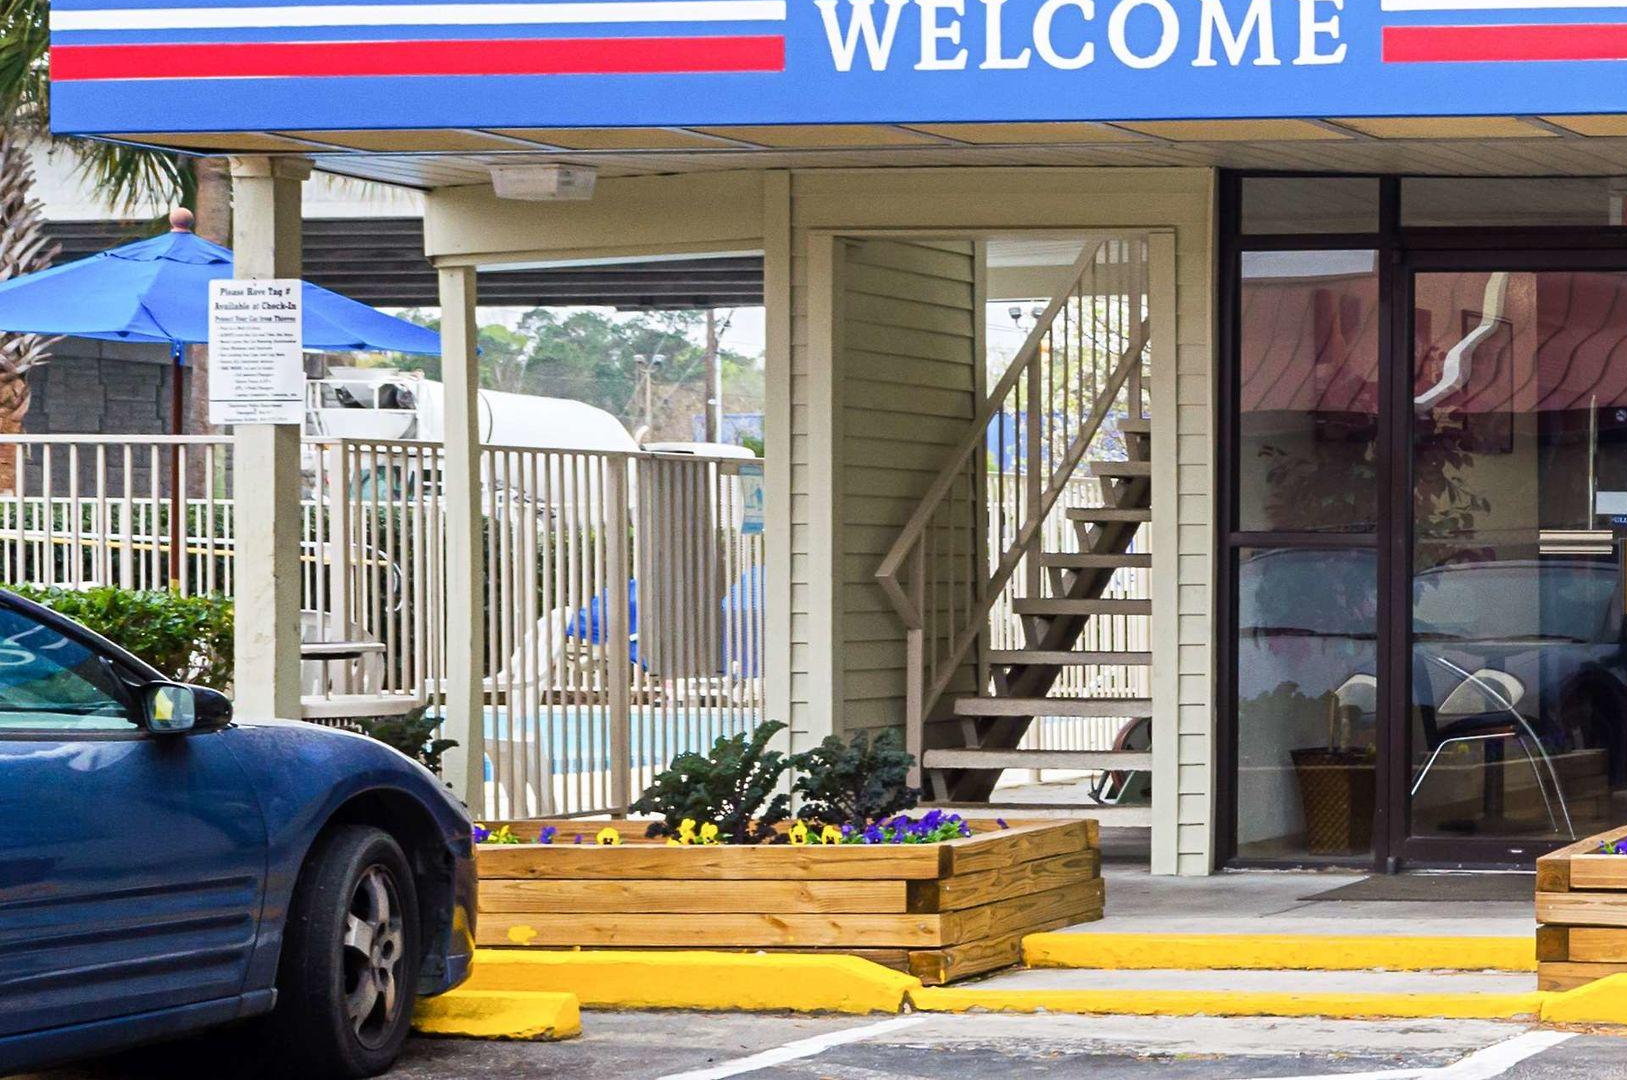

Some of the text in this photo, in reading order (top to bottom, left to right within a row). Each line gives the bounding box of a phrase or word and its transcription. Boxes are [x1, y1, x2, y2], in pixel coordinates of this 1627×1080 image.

[220, 287, 244, 296] Please
[247, 287, 265, 296] Have
[268, 287, 283, 297] Tag
[215, 302, 297, 310] Available at Check-In
